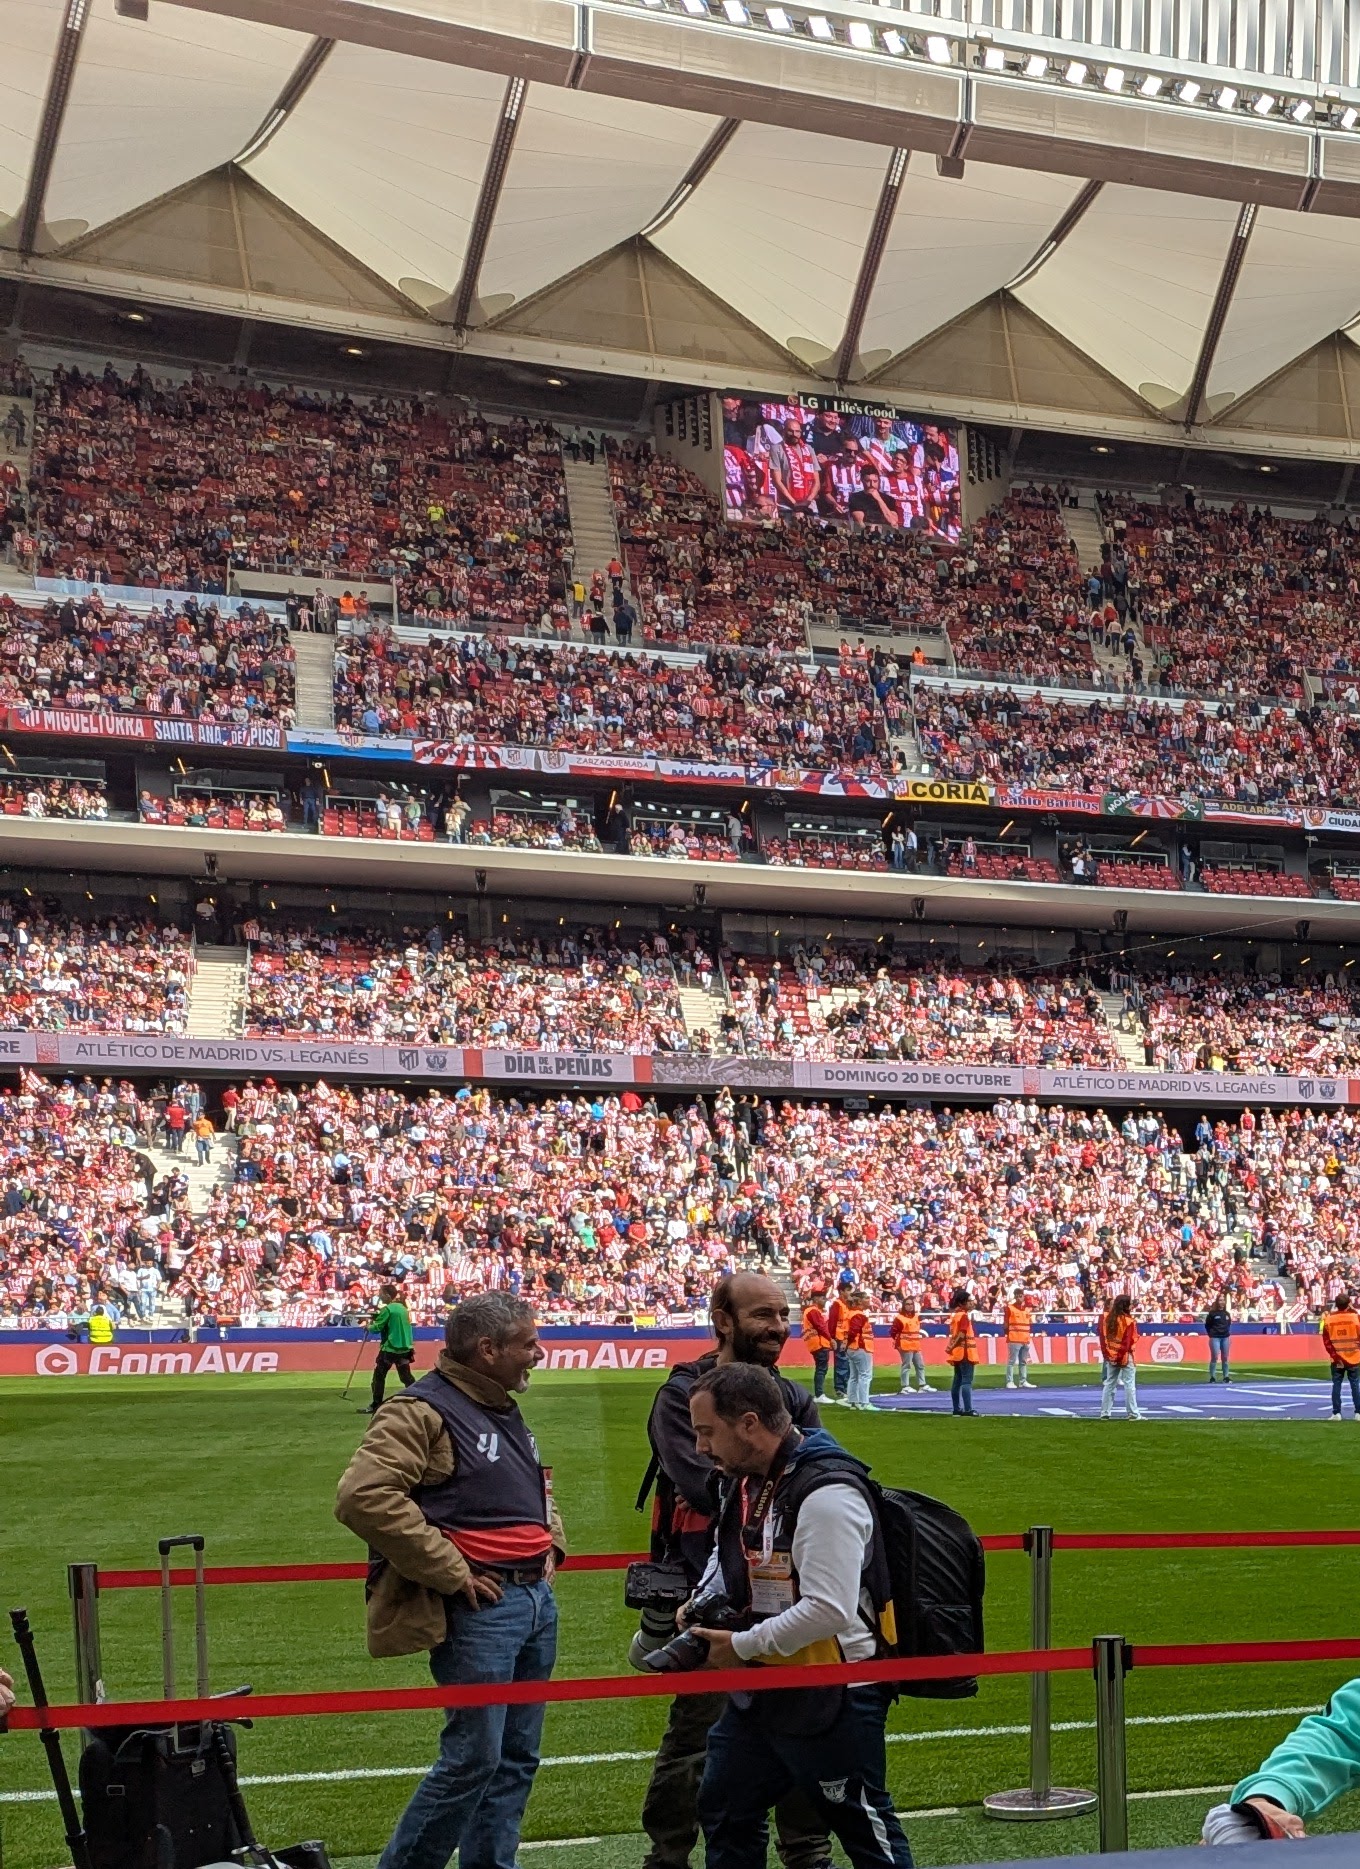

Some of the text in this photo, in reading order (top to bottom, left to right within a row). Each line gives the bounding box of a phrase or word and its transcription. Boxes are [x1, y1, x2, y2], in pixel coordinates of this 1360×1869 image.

[800, 395, 899, 420] LG Life's Good.
[155, 720, 194, 742] SANTA
[199, 726, 222, 744] ANA
[250, 728, 280, 748] PUSA
[576, 757, 649, 769] ZARZAQUEMADA
[671, 767, 739, 780] MÁLAGA
[912, 781, 986, 802] CORIA
[1000, 794, 1100, 812] Pablo Barrios
[1222, 802, 1279, 816] ADELARDO
[75, 1041, 369, 1065] ATLÉTICO DE MADRID VS. LEGANÉS
[504, 1052, 536, 1074] DÍA
[555, 1054, 613, 1077] PEÑAS
[824, 1069, 1012, 1087] DOMINGO 20 DE OCTUBRE
[1053, 1075, 1277, 1095] ATLÉTICO DE MADRID VS. LEGANÉS
[1156, 1353, 1179, 1361] SPORTS
[1157, 1343, 1178, 1353] EA
[88, 1345, 279, 1376] ComAve
[754, 1480, 774, 1518] Canon
